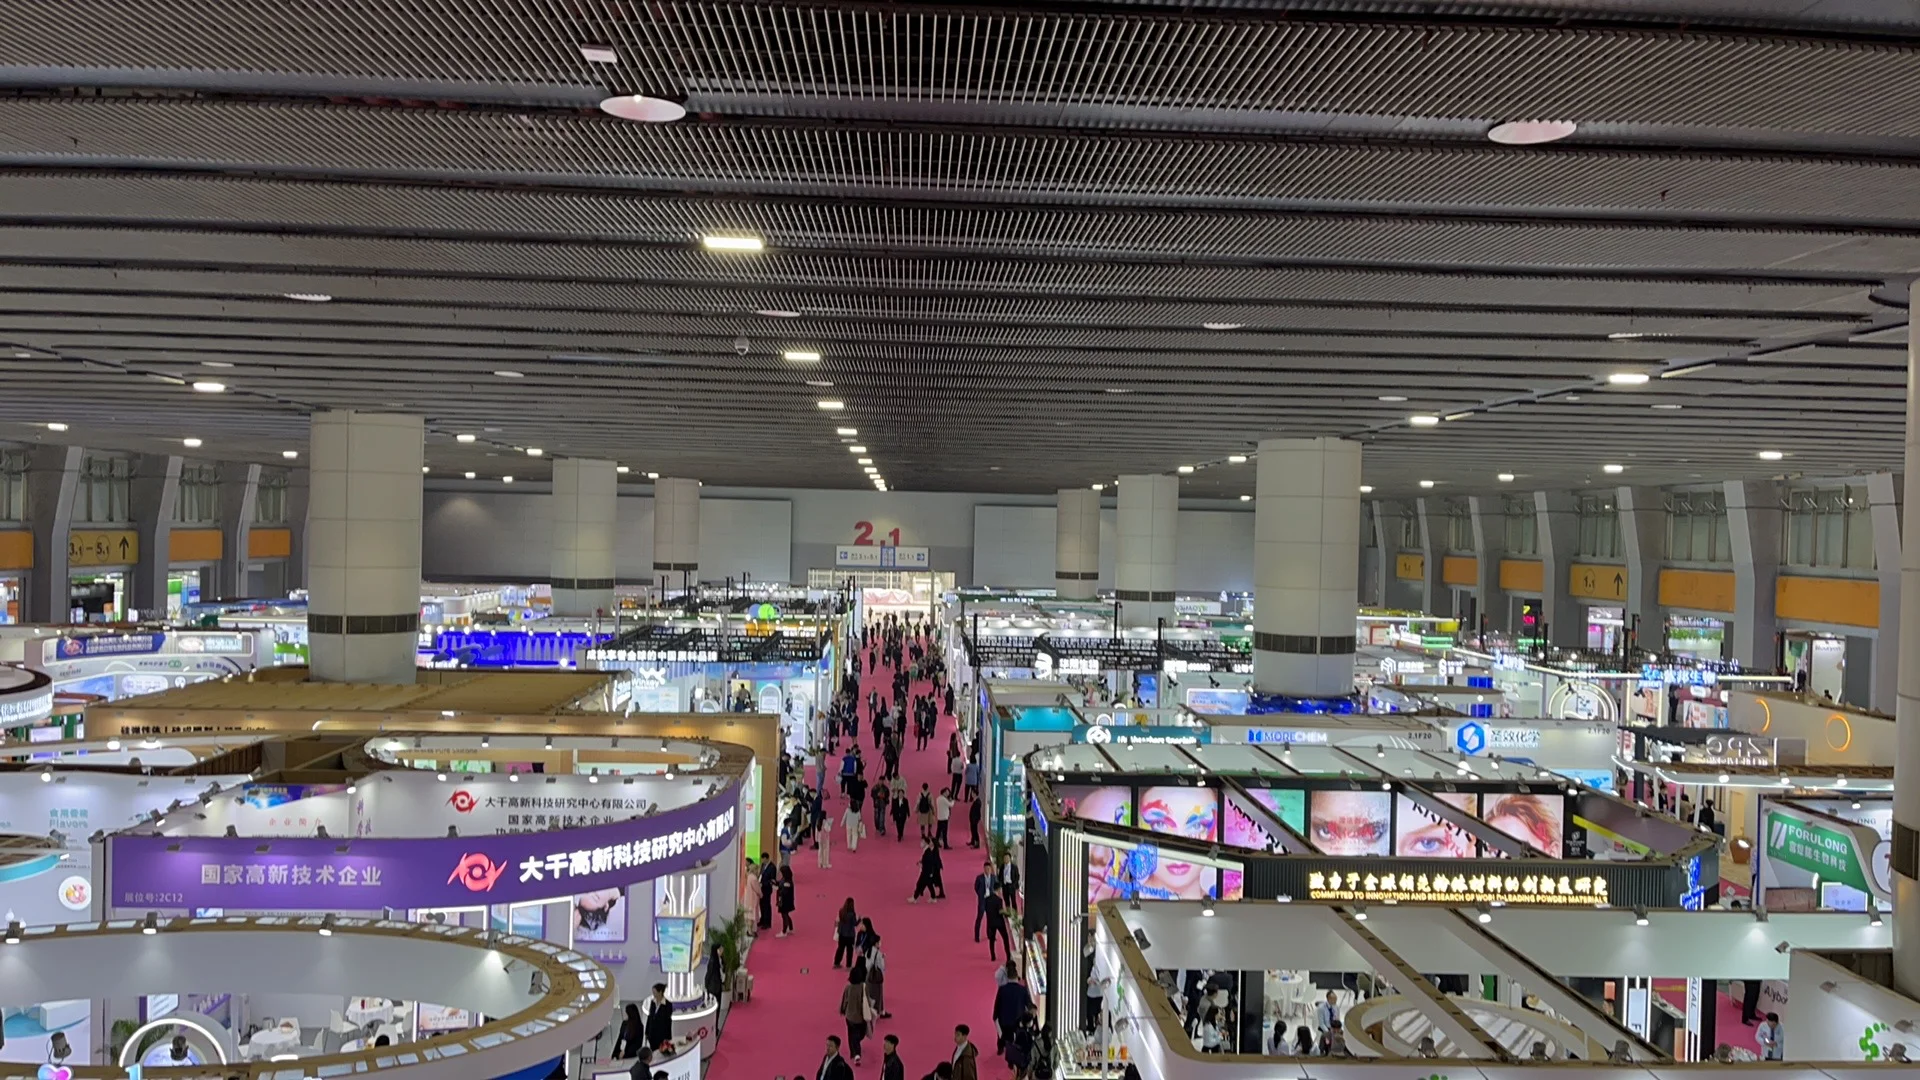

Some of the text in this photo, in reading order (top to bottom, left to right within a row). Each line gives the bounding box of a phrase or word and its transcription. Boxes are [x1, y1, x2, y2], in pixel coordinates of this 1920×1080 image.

[853, 520, 900, 546] 2.1
[96, 541, 110, 555] 5.1
[1584, 575, 1595, 588] 1.1
[1264, 731, 1328, 743] MORECHEM
[1788, 824, 1848, 855] FORULONG
[201, 863, 383, 886] 国家高新技术企业
[124, 892, 184, 904] 展位号:2C12
[1310, 890, 1354, 899] COMMITTED
[1354, 891, 1365, 900] TO
[1411, 892, 1427, 901] AND
[1427, 892, 1465, 902] RESEARCH
[1465, 893, 1475, 902] OF
[1536, 894, 1567, 904] POWDER
